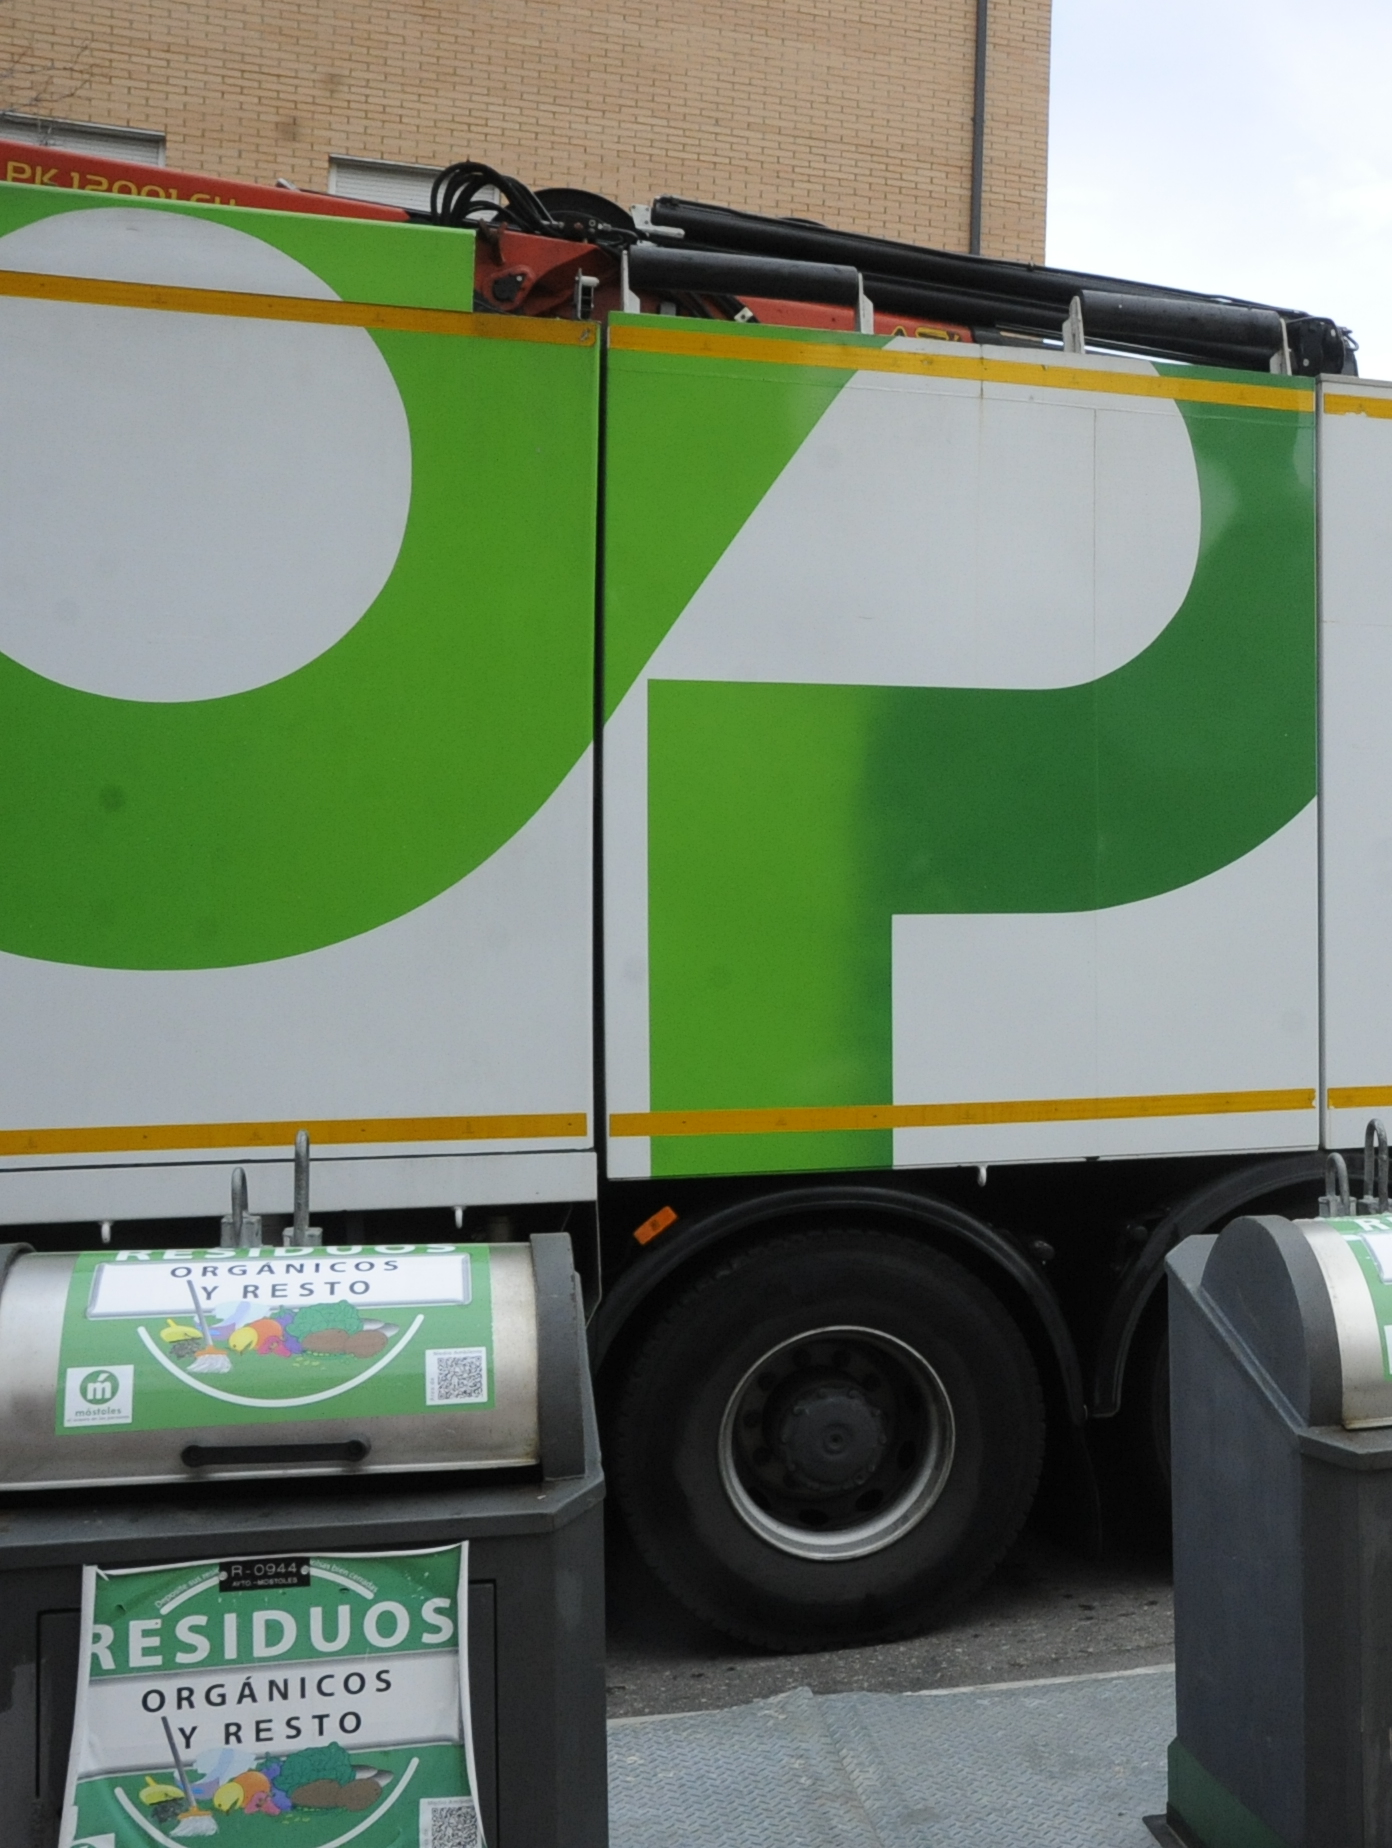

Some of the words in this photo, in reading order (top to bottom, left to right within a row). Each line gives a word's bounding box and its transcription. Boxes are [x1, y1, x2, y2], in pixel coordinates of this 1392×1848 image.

[170, 1260, 400, 1278] ORGÁNICOS
[200, 1285, 220, 1301] Y
[242, 1280, 371, 1299] RESTO
[91, 1598, 455, 1670] RESIDUOS
[141, 1669, 392, 1713] ORGÁNICOS
[178, 1726, 198, 1750] Y
[224, 1711, 362, 1745] RESTO
